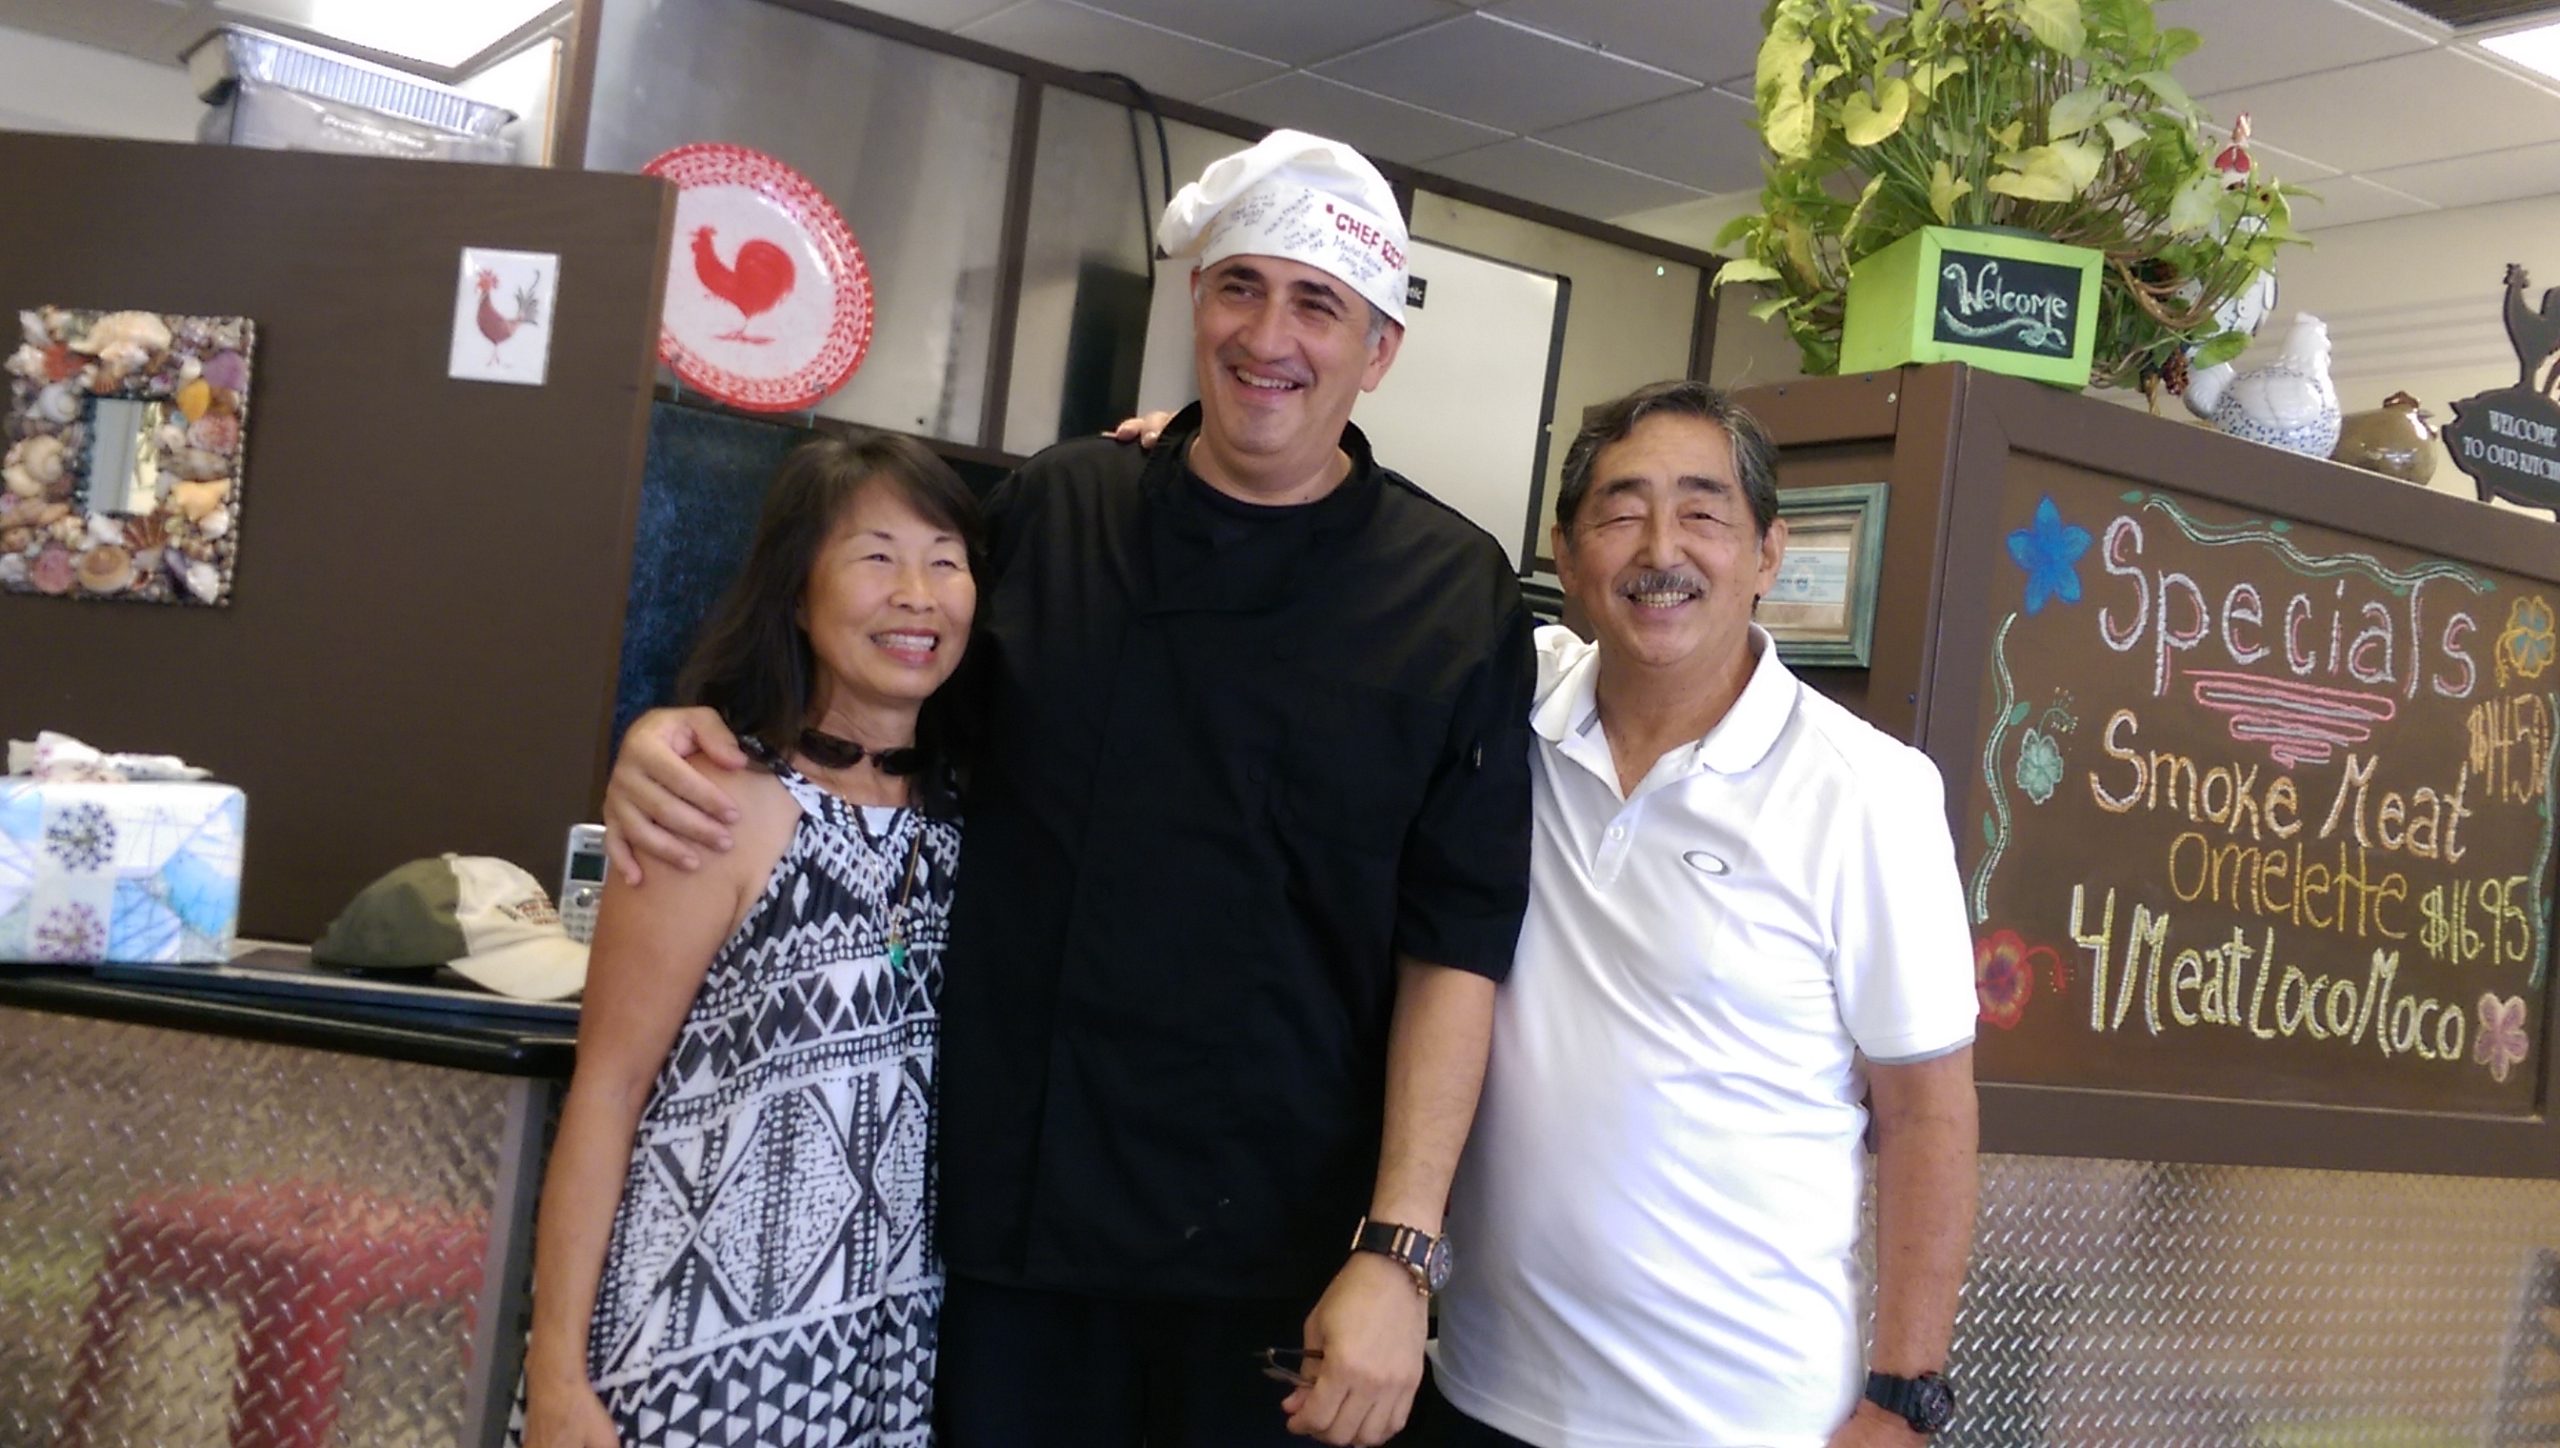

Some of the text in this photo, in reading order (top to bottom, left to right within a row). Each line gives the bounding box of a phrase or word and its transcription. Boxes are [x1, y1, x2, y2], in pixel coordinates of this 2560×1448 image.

[1942, 261, 2068, 328] Welcome
[2463, 436, 2486, 459] TO
[2486, 444, 2519, 470] OUR
[2488, 409, 2558, 449] WELCOME
[2100, 515, 2478, 700] Specials
[2089, 708, 2474, 864] Smoke Meat
[2069, 883, 2117, 1033] 4
[2169, 832, 2530, 965] Omelette $16.95
